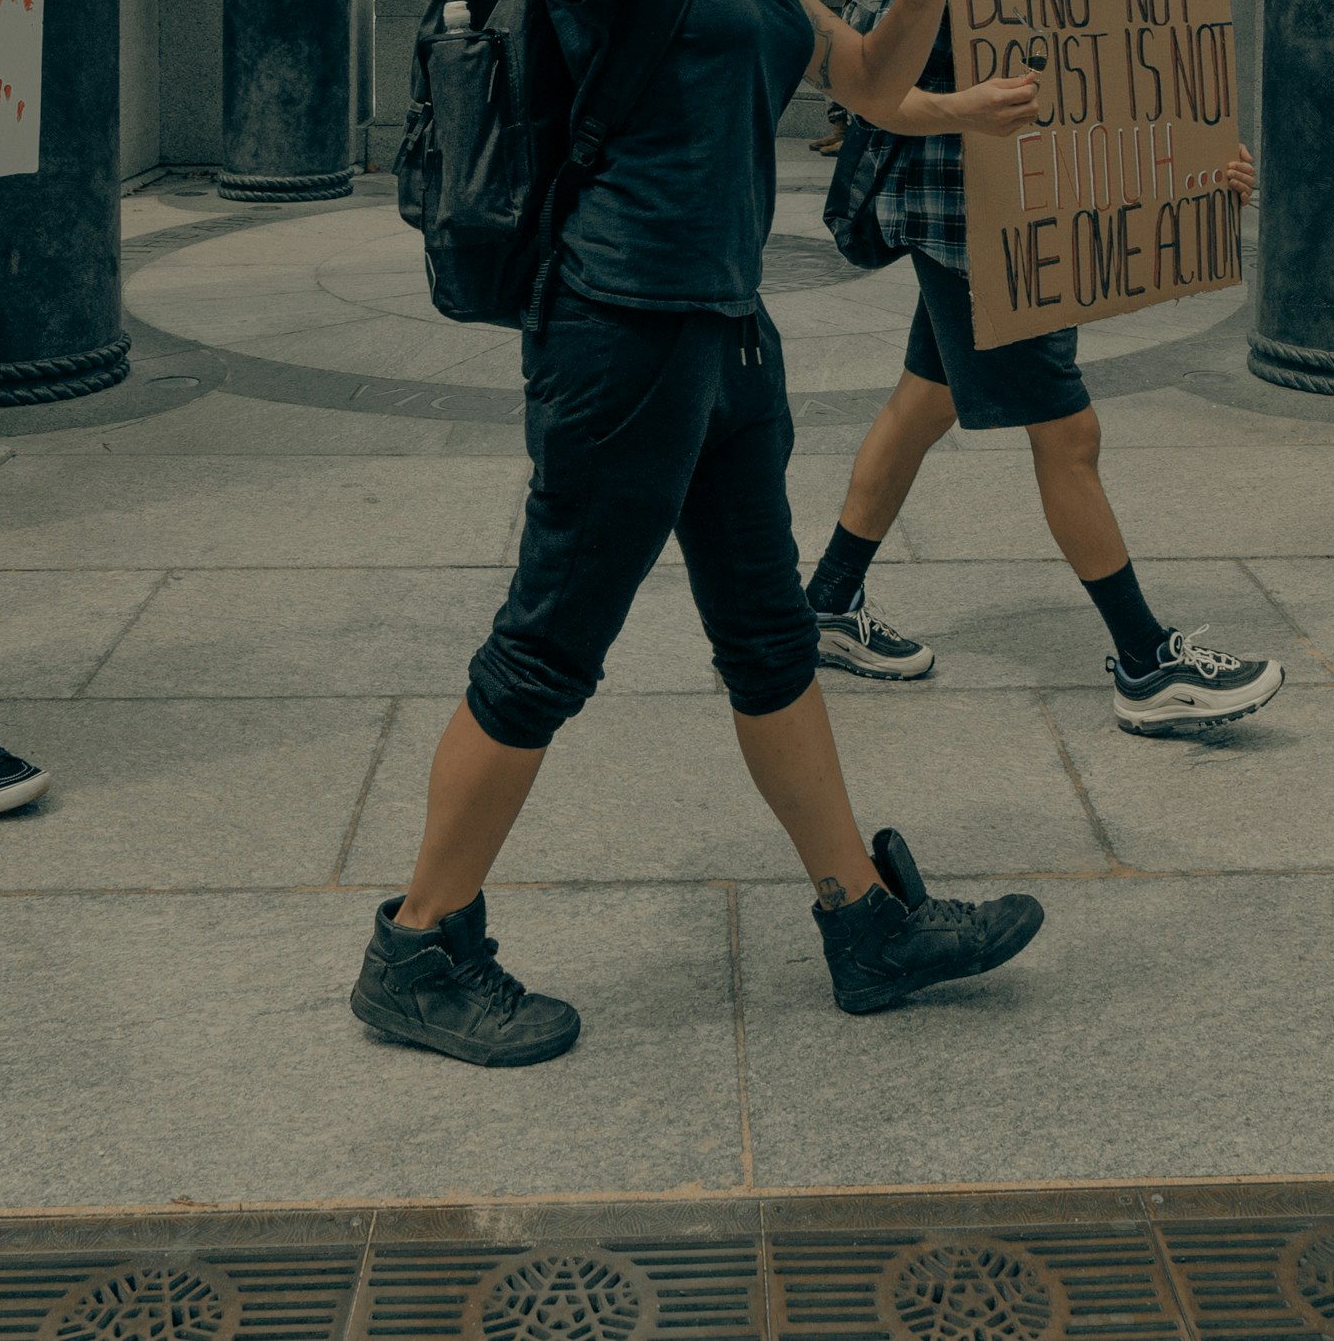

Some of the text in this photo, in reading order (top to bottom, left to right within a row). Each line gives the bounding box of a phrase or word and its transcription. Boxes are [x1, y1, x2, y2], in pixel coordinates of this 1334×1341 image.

[1125, 26, 1162, 121] IS
[1169, 21, 1233, 125] NOT
[1002, 188, 1243, 312] WE OWE ACTION
